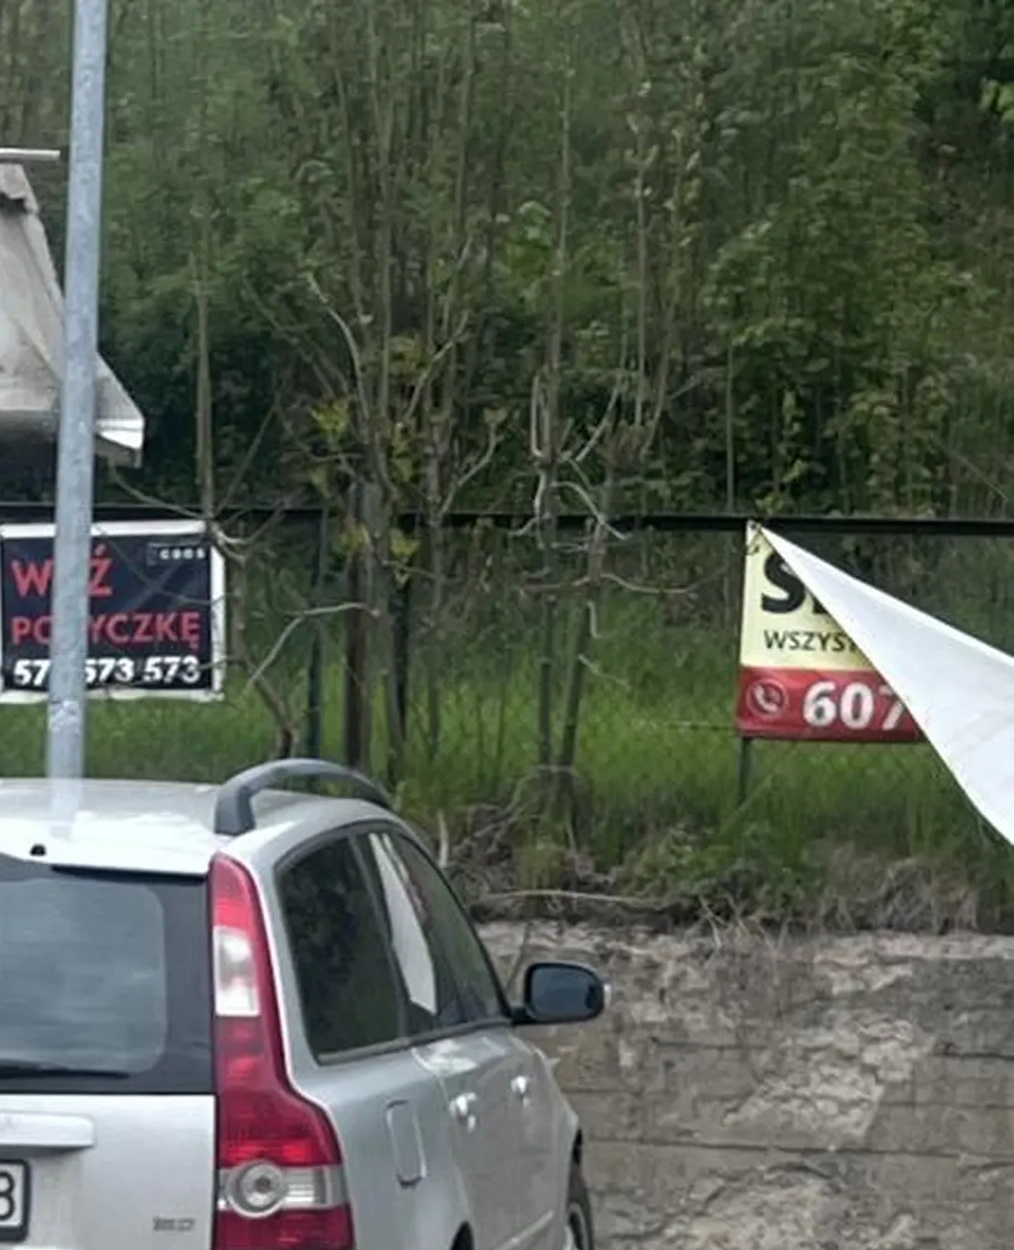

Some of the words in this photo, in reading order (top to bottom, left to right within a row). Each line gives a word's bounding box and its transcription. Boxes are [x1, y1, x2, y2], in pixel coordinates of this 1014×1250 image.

[11, 545, 112, 598] WŹ
[761, 551, 829, 615] S
[11, 611, 201, 652] POYCZKĘ
[13, 658, 51, 686] 57
[143, 655, 201, 683] 573
